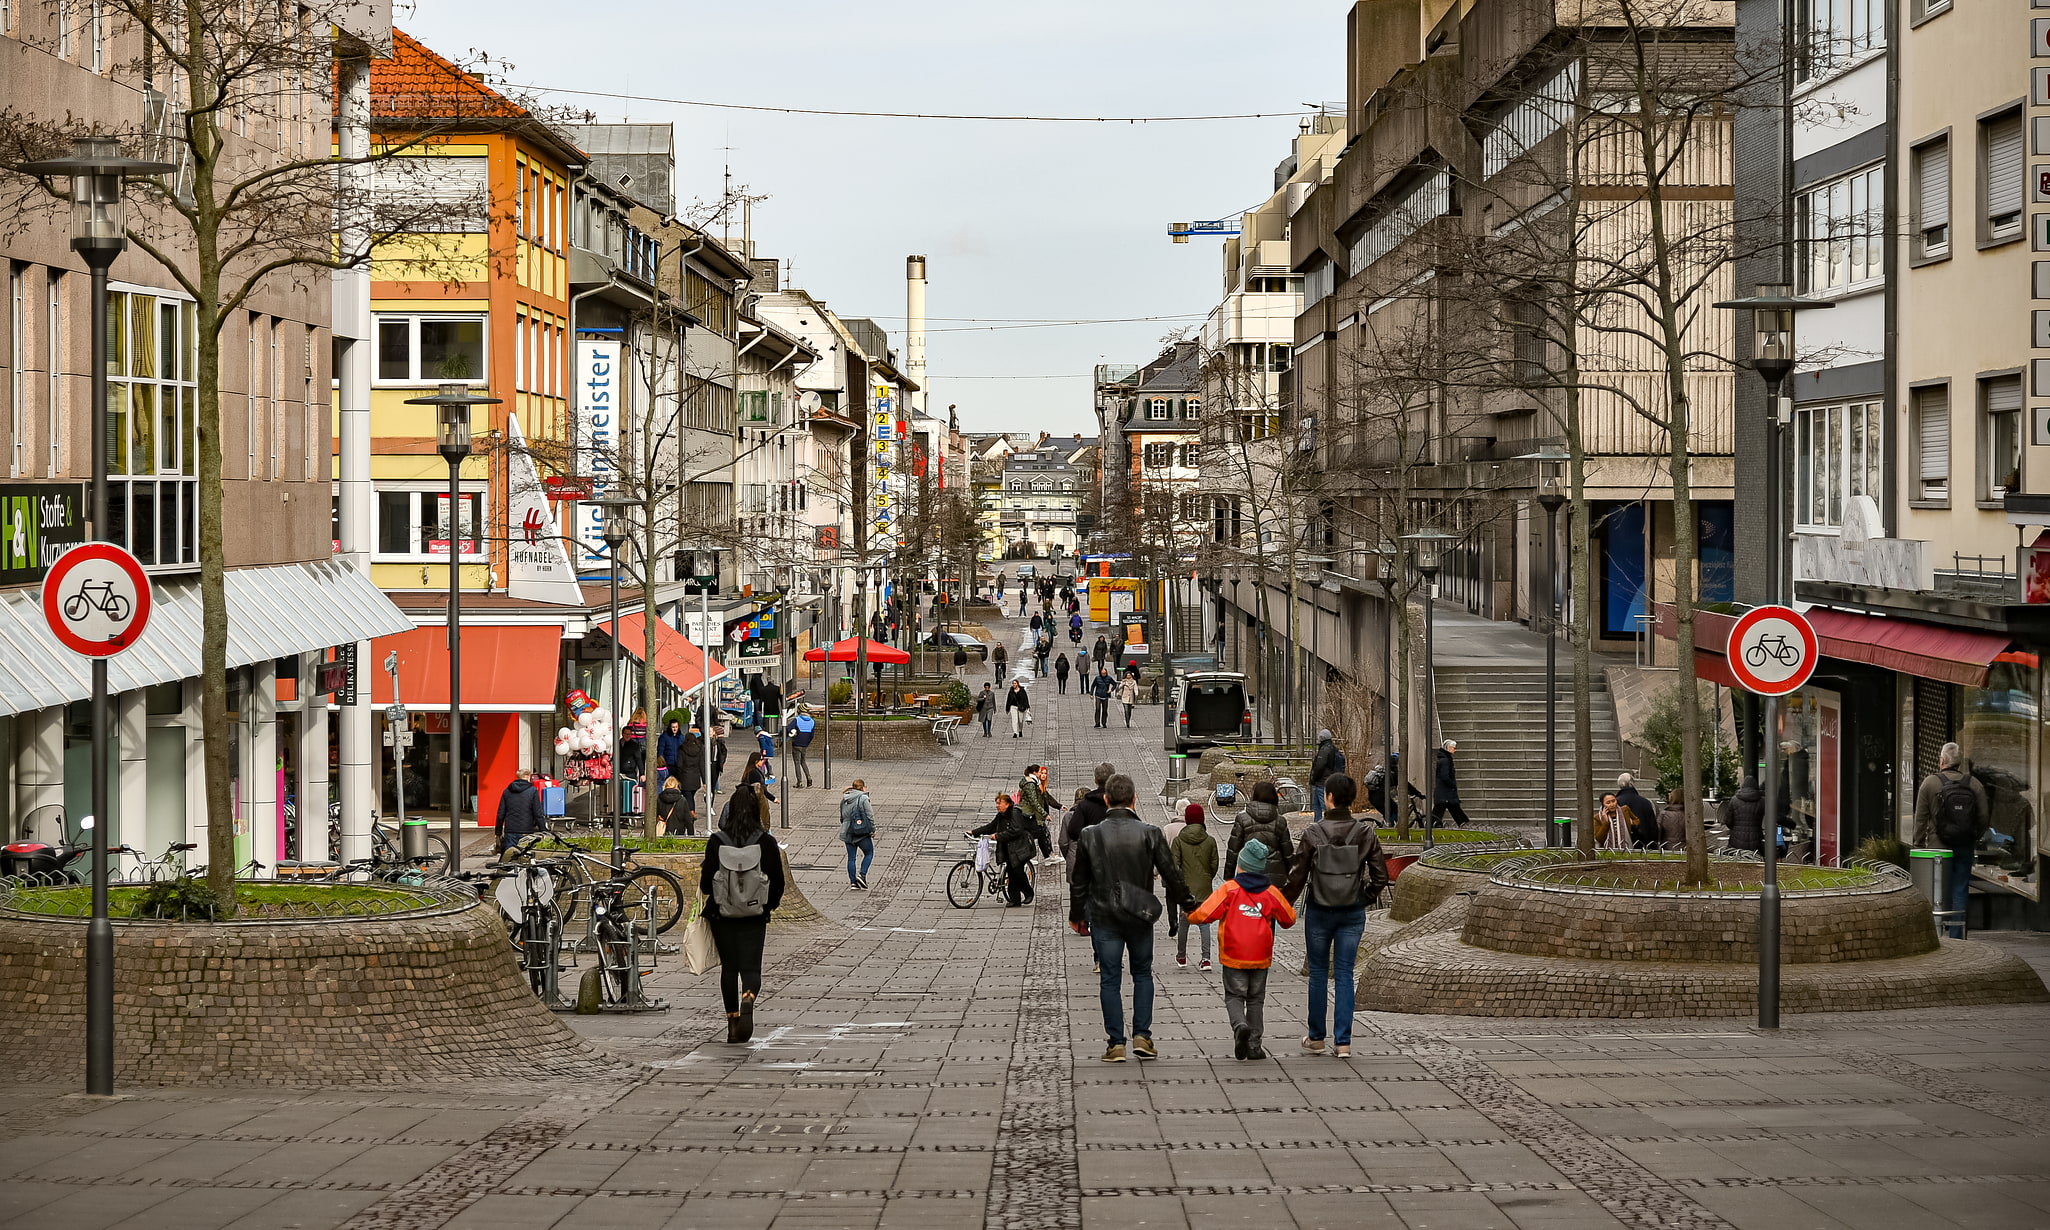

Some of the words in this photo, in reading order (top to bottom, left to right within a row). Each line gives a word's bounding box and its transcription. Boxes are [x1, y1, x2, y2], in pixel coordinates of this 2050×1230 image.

[585, 349, 611, 560] Kücenmeister
[40, 494, 65, 528] Stoffe
[66, 495, 73, 527] &
[514, 551, 552, 564] HUFNAGEL
[728, 657, 777, 666] ELISABETHENSTRASSE
[1901, 760, 1913, 785] SAL
